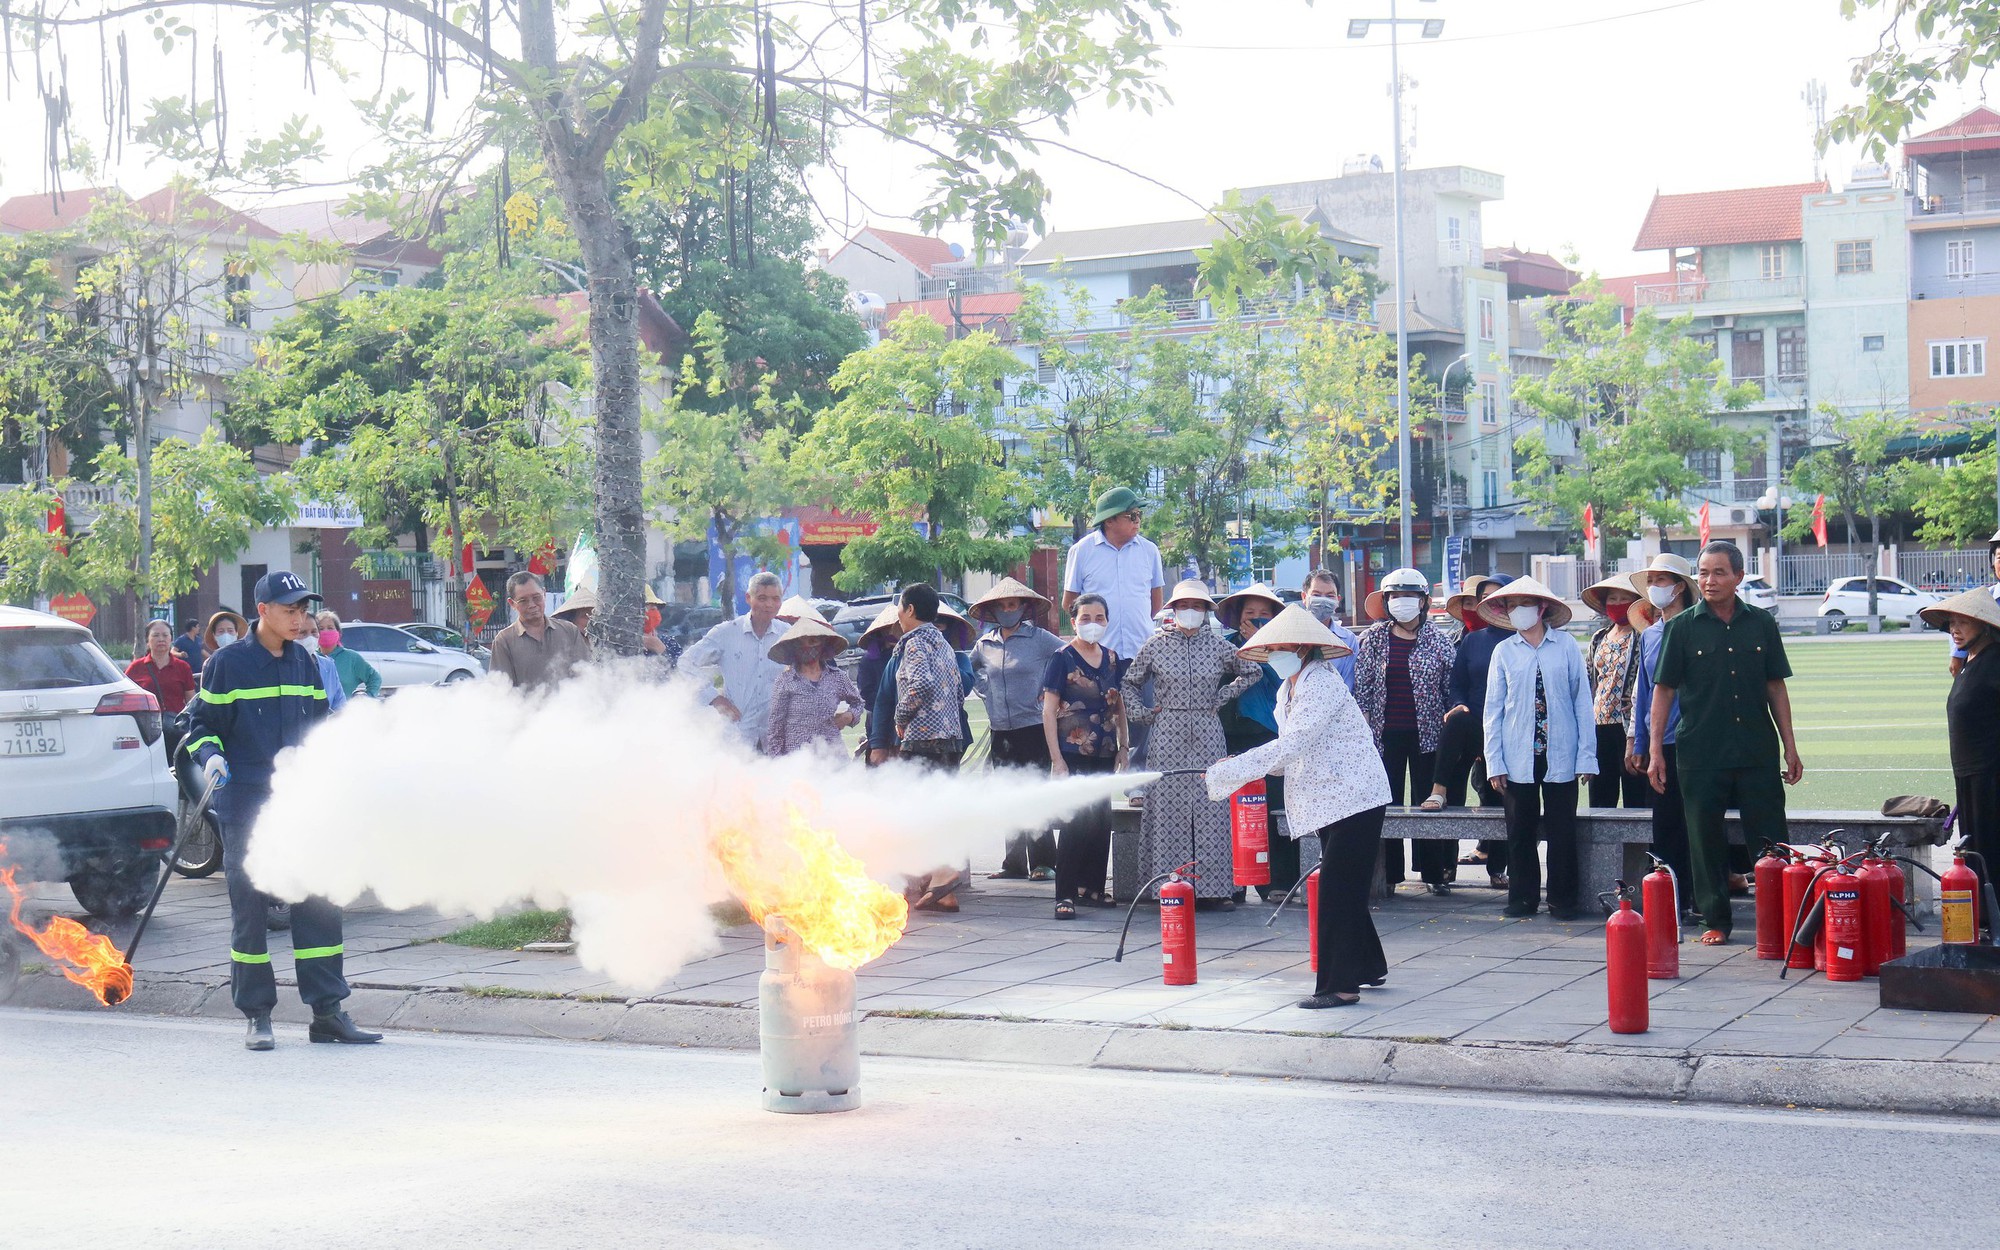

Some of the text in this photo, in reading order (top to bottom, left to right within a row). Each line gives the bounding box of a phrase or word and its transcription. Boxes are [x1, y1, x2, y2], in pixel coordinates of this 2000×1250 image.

[282, 574, 306, 589] 114
[14, 721, 43, 737] 30H
[4, 738, 57, 754] 711.92
[803, 1014, 832, 1028] PETRO
